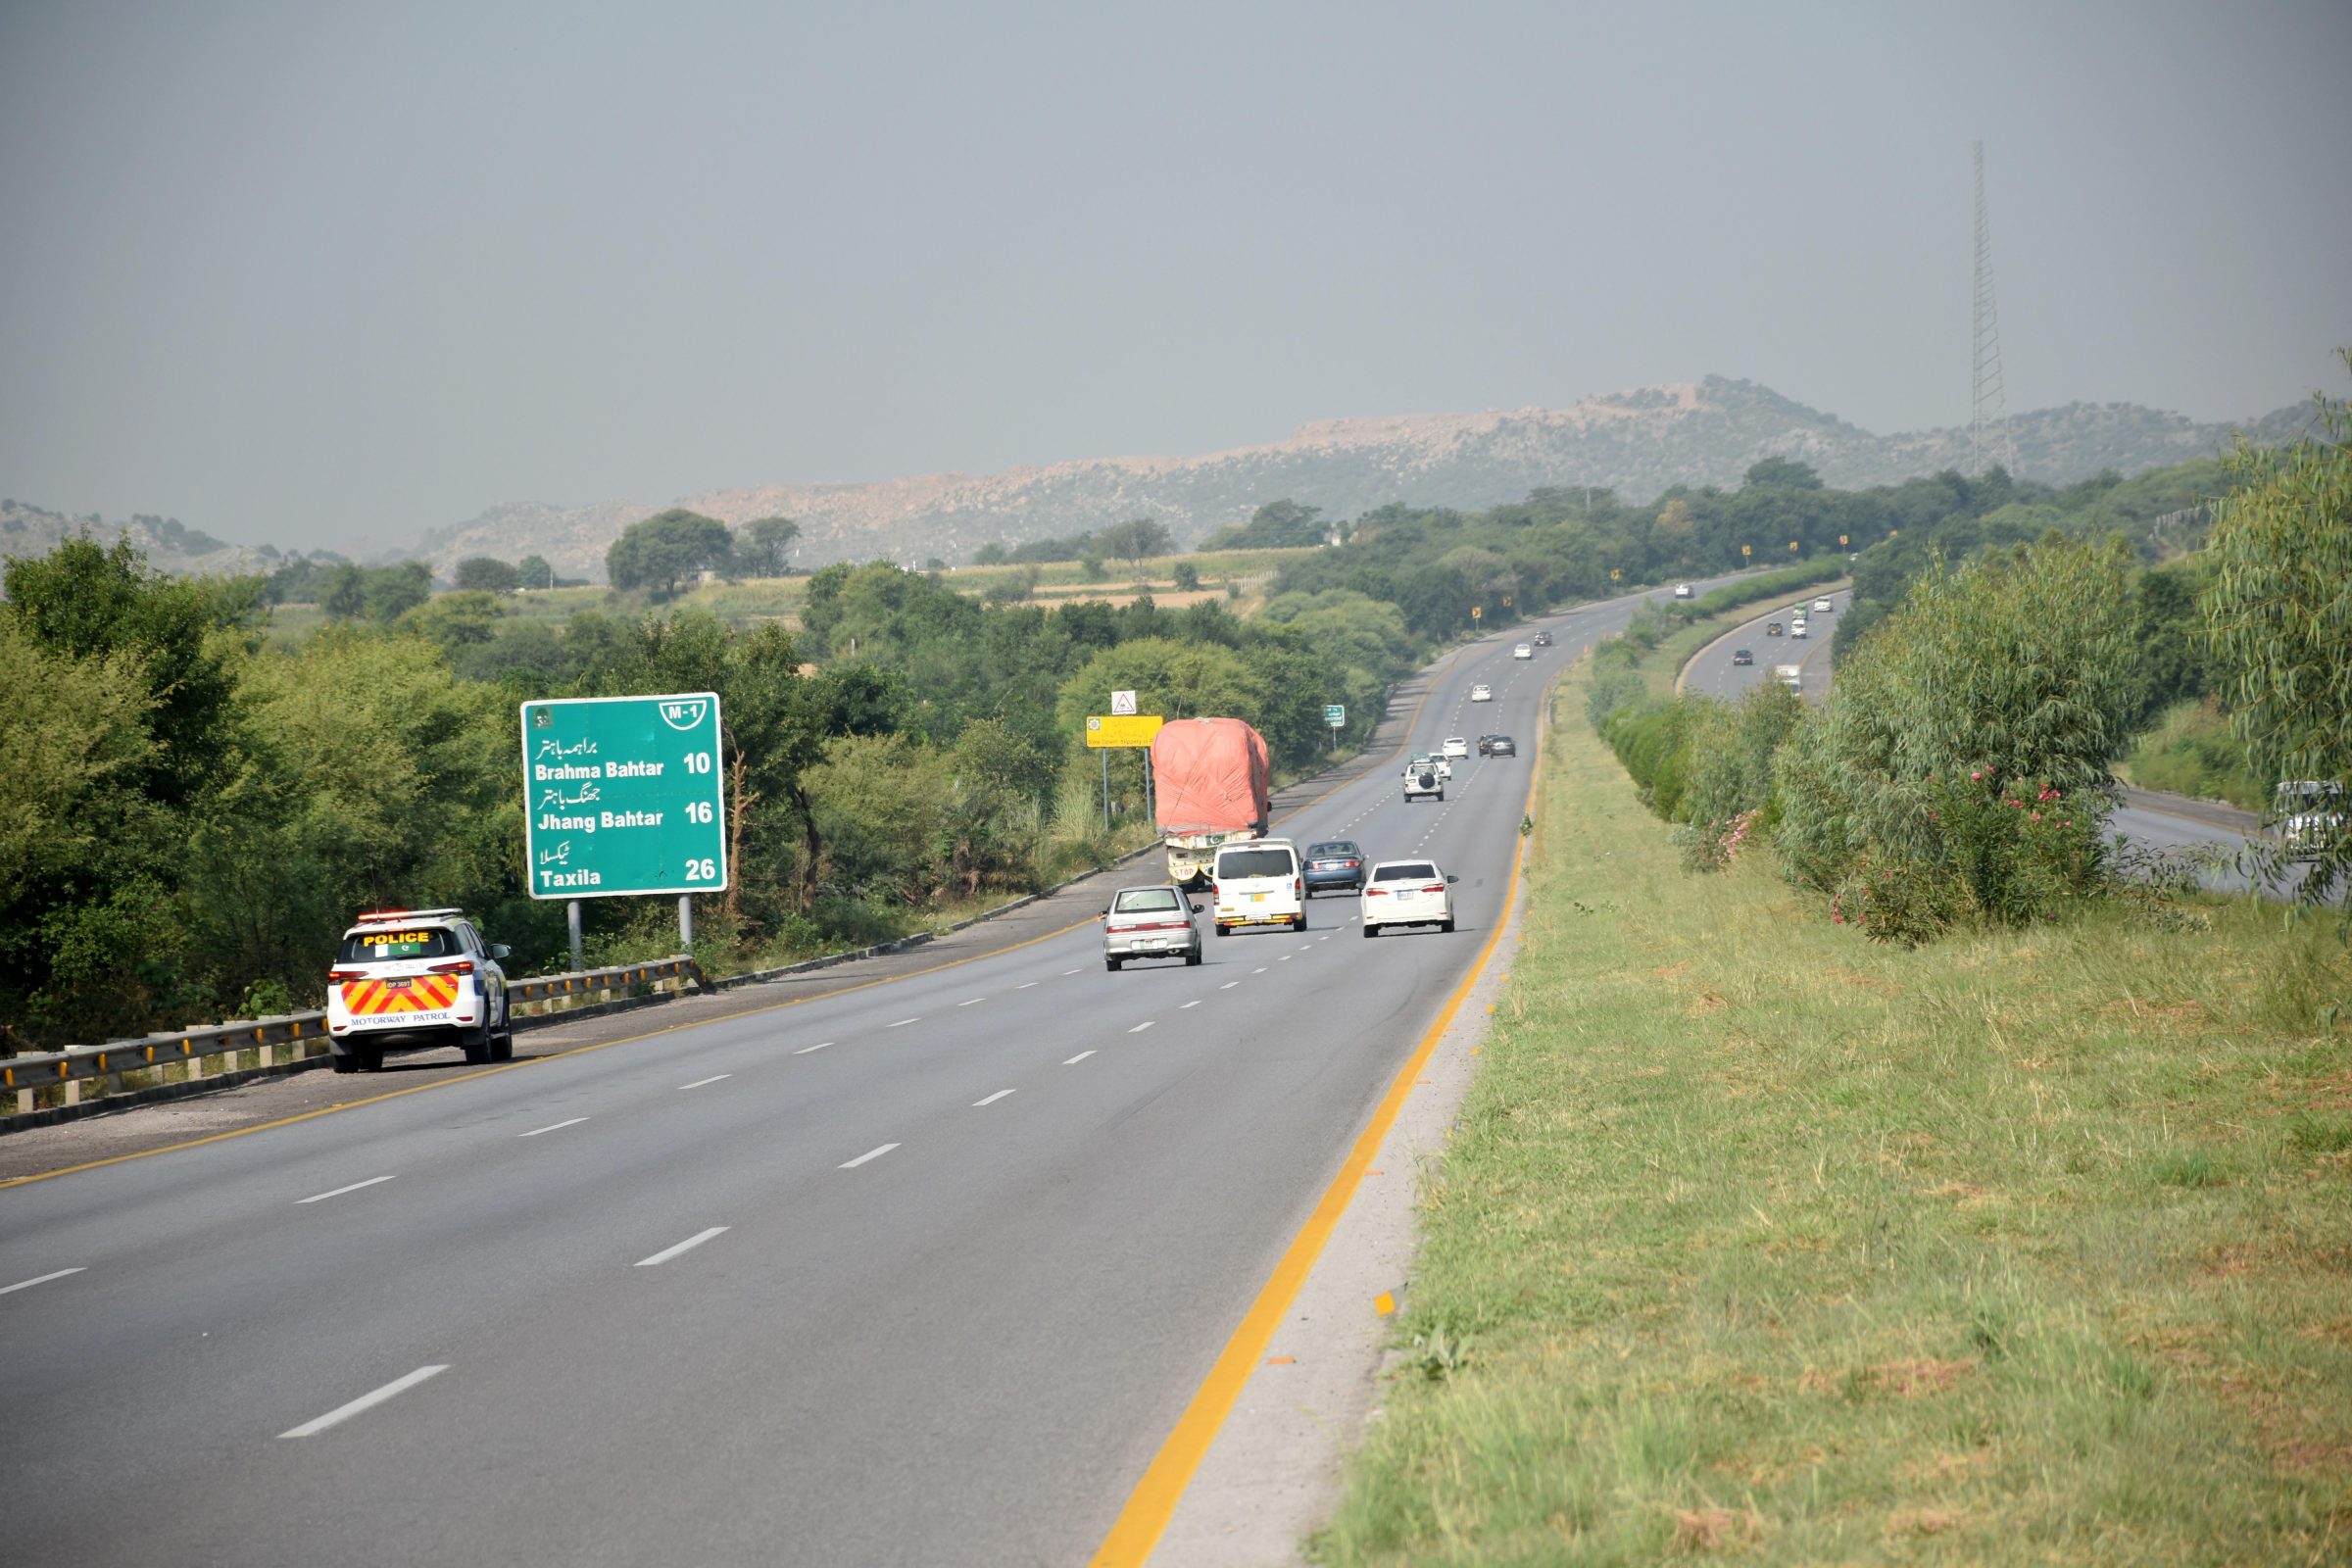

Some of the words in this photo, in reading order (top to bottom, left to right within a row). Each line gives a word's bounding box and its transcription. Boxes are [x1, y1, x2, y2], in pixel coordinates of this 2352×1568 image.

[668, 706, 698, 719] M-1
[535, 762, 602, 781] Brahma
[606, 760, 664, 777] Bahtar
[683, 752, 710, 774] 10
[537, 813, 596, 833] Jhang
[601, 810, 663, 828] Bahtar
[685, 802, 713, 824] 16
[540, 869, 601, 887] Taxila
[685, 858, 715, 881] 26
[364, 931, 429, 948] POLICE
[351, 1014, 407, 1027] MOTORWAY
[413, 1011, 451, 1022] PATROL
